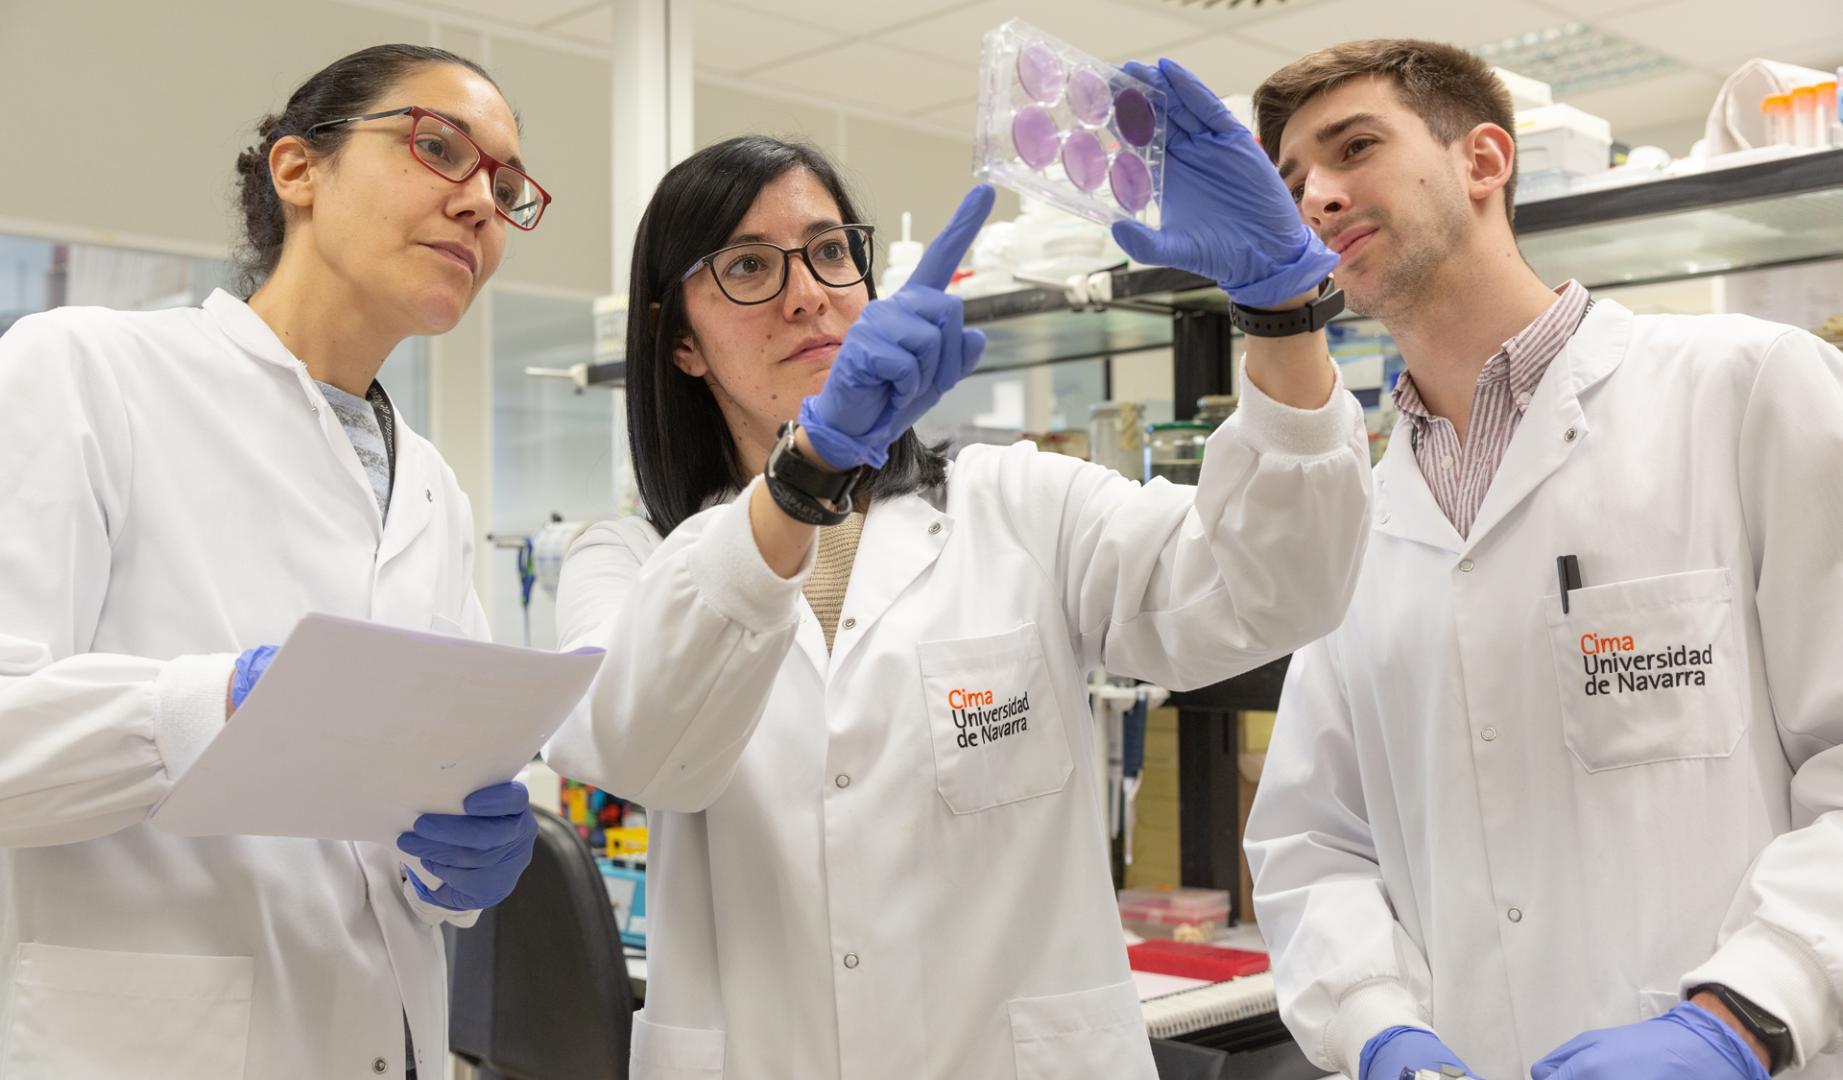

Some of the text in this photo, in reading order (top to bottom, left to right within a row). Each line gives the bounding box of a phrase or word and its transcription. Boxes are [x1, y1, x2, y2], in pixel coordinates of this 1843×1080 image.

[1580, 633, 1634, 655] Cima
[1583, 644, 1712, 675] Universidad
[1585, 669, 1705, 697] de Navarra
[948, 688, 993, 710] Cima
[951, 691, 1030, 729] Universidad
[957, 716, 1028, 748] de Navarra
